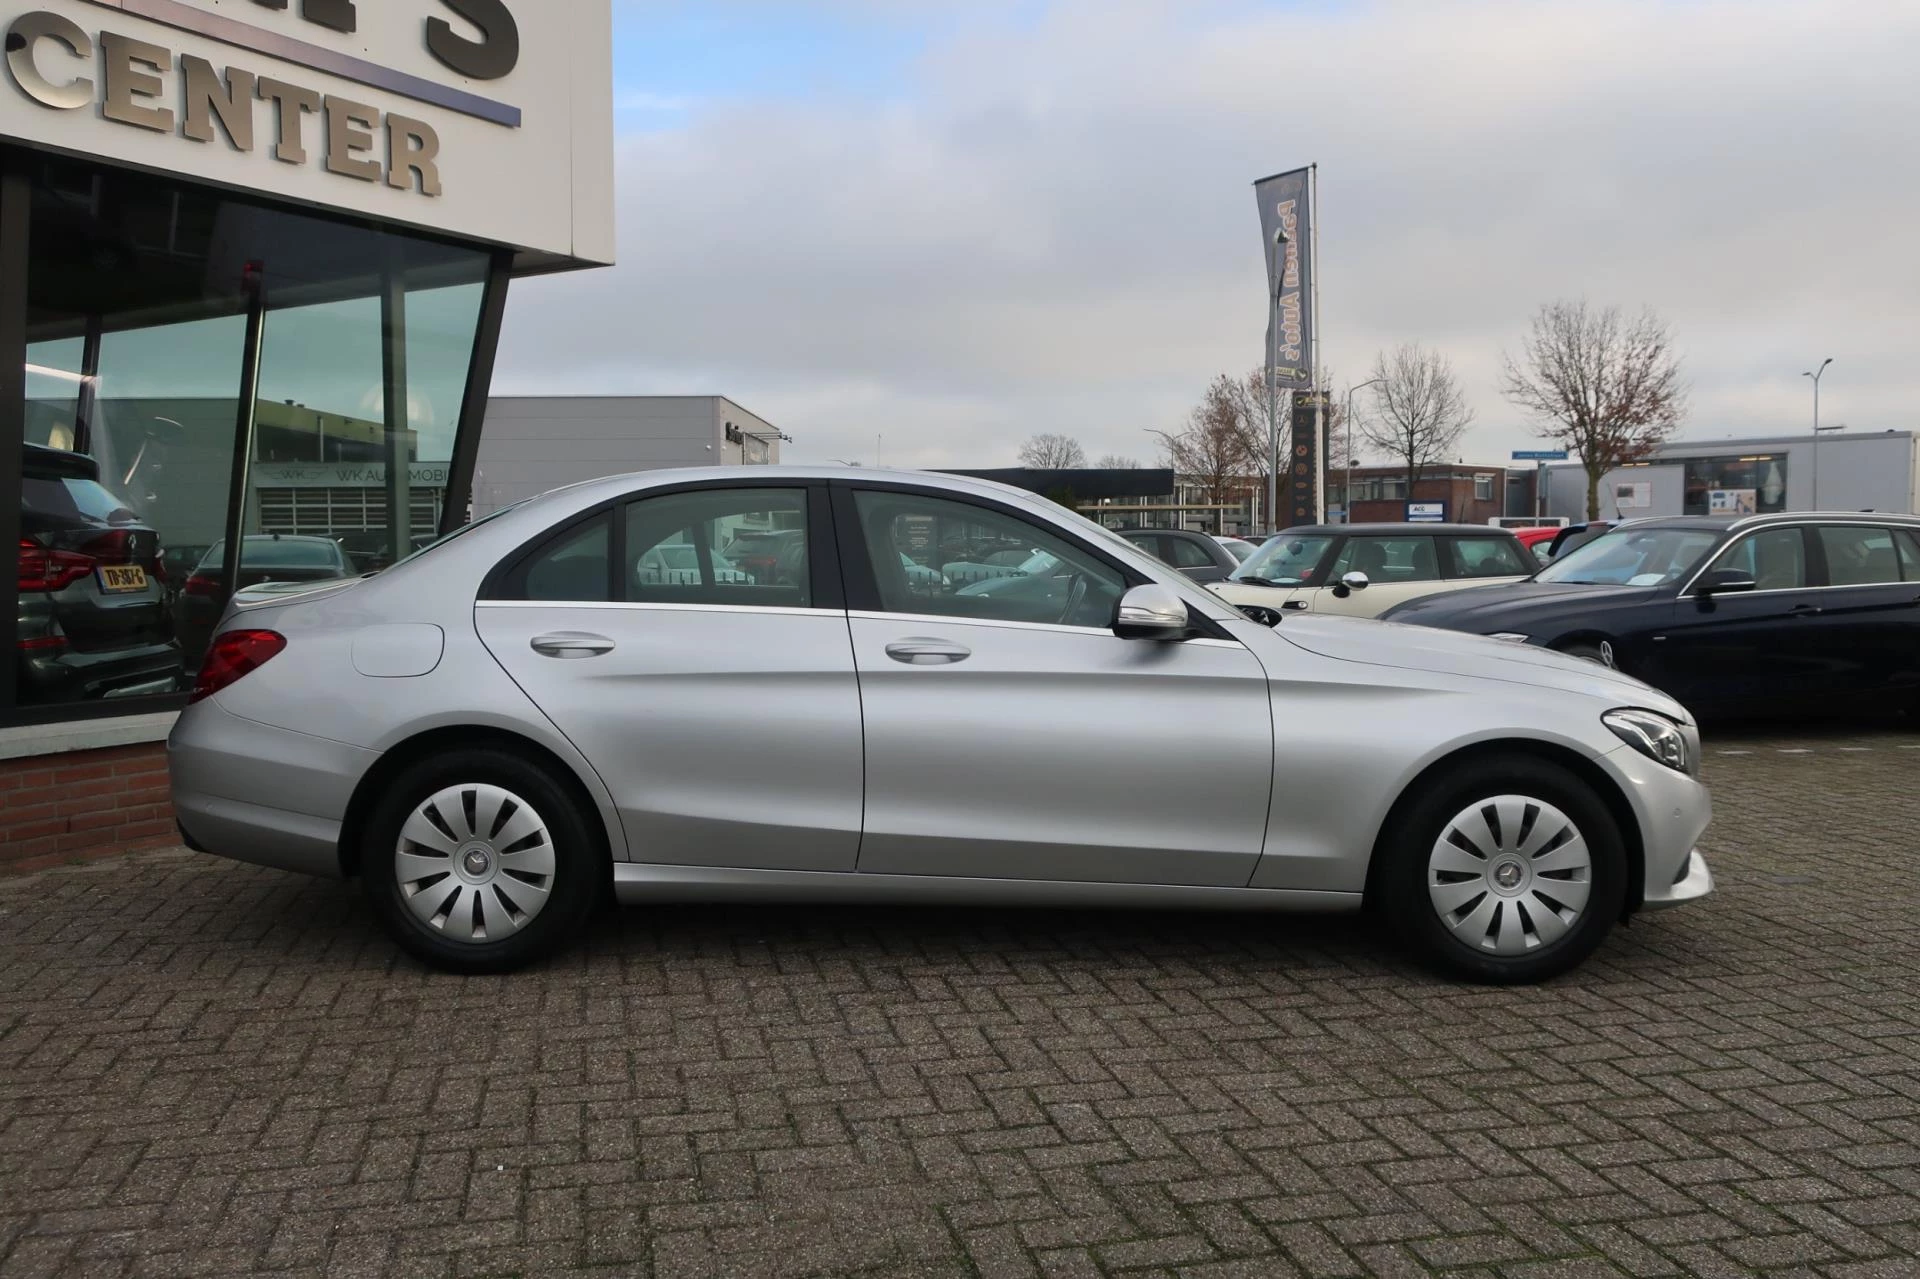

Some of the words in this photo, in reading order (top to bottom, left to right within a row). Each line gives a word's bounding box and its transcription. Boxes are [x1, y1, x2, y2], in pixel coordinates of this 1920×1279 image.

[5, 10, 442, 196] CENTER
[336, 469, 364, 482] WK
[366, 469, 447, 482] AUMOBI
